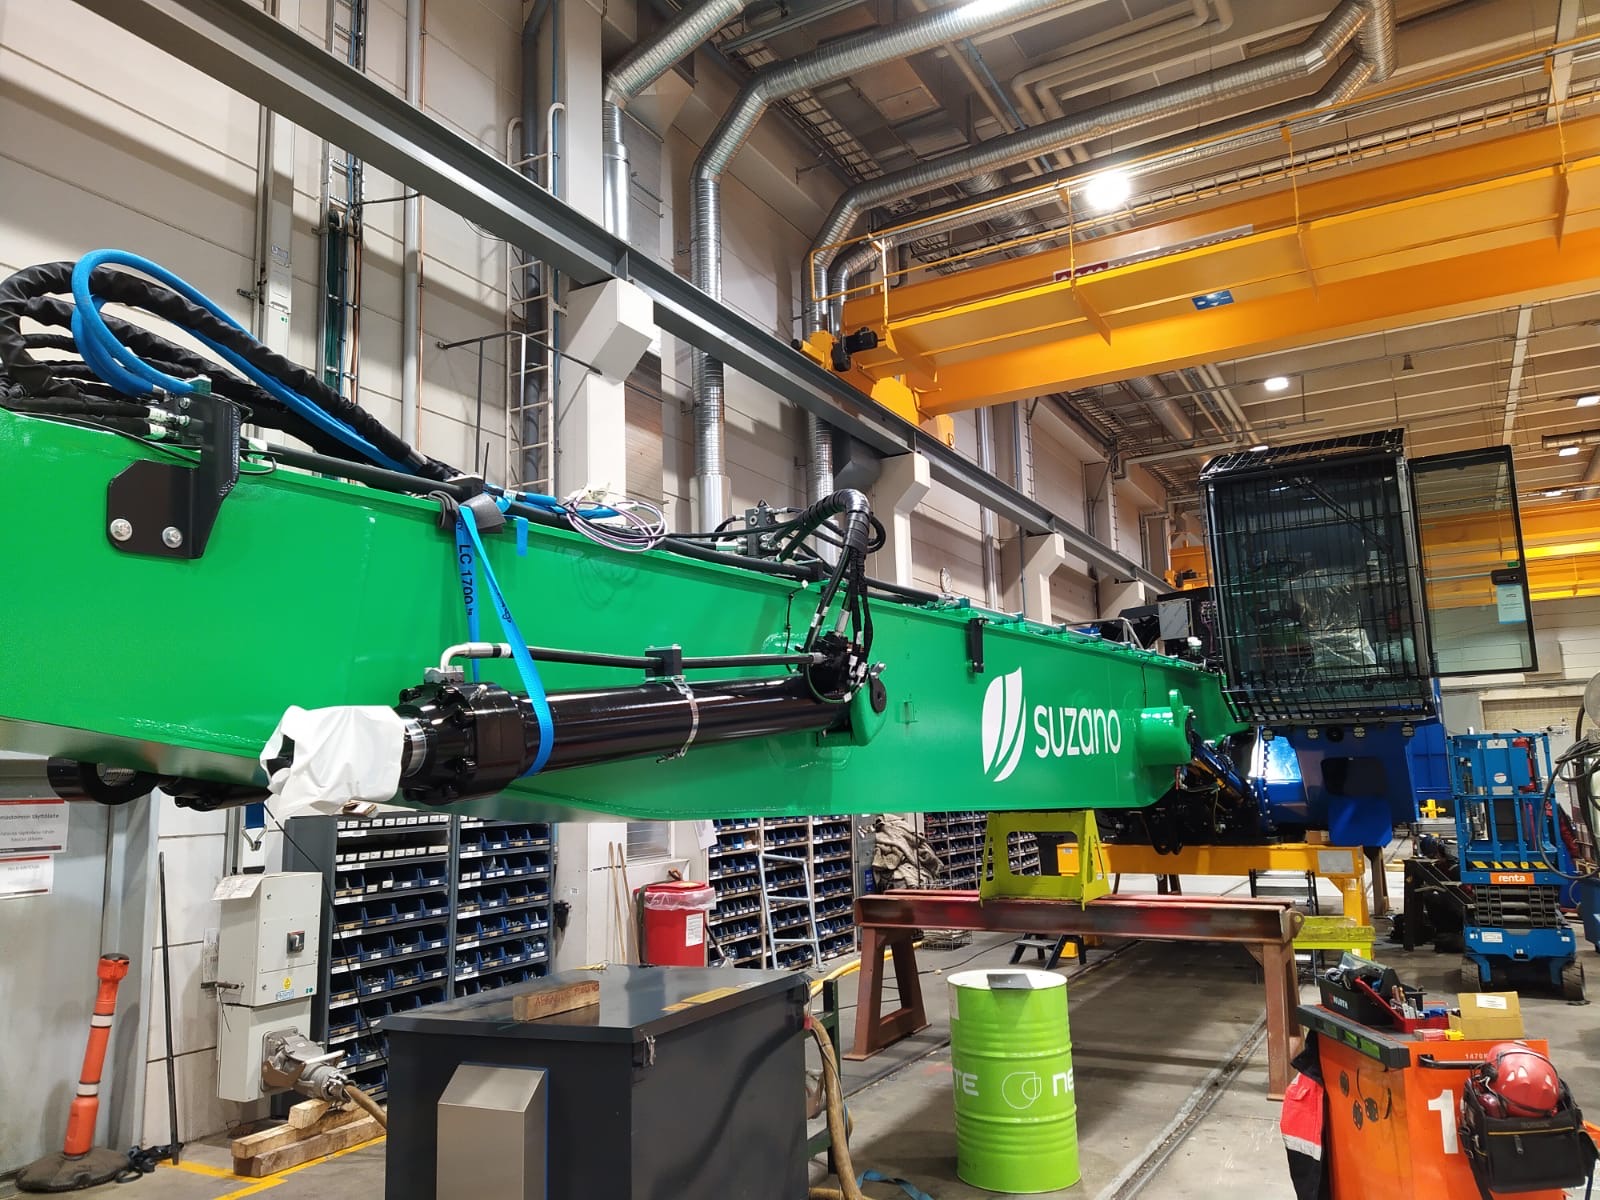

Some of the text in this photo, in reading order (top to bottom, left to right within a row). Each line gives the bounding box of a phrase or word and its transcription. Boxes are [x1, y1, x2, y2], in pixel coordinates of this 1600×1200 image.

[459, 545, 472, 565] LC
[461, 569, 474, 605] 1700
[1034, 705, 1121, 758] suzano
[1498, 874, 1526, 882] renta
[1428, 1089, 1459, 1154] 1
